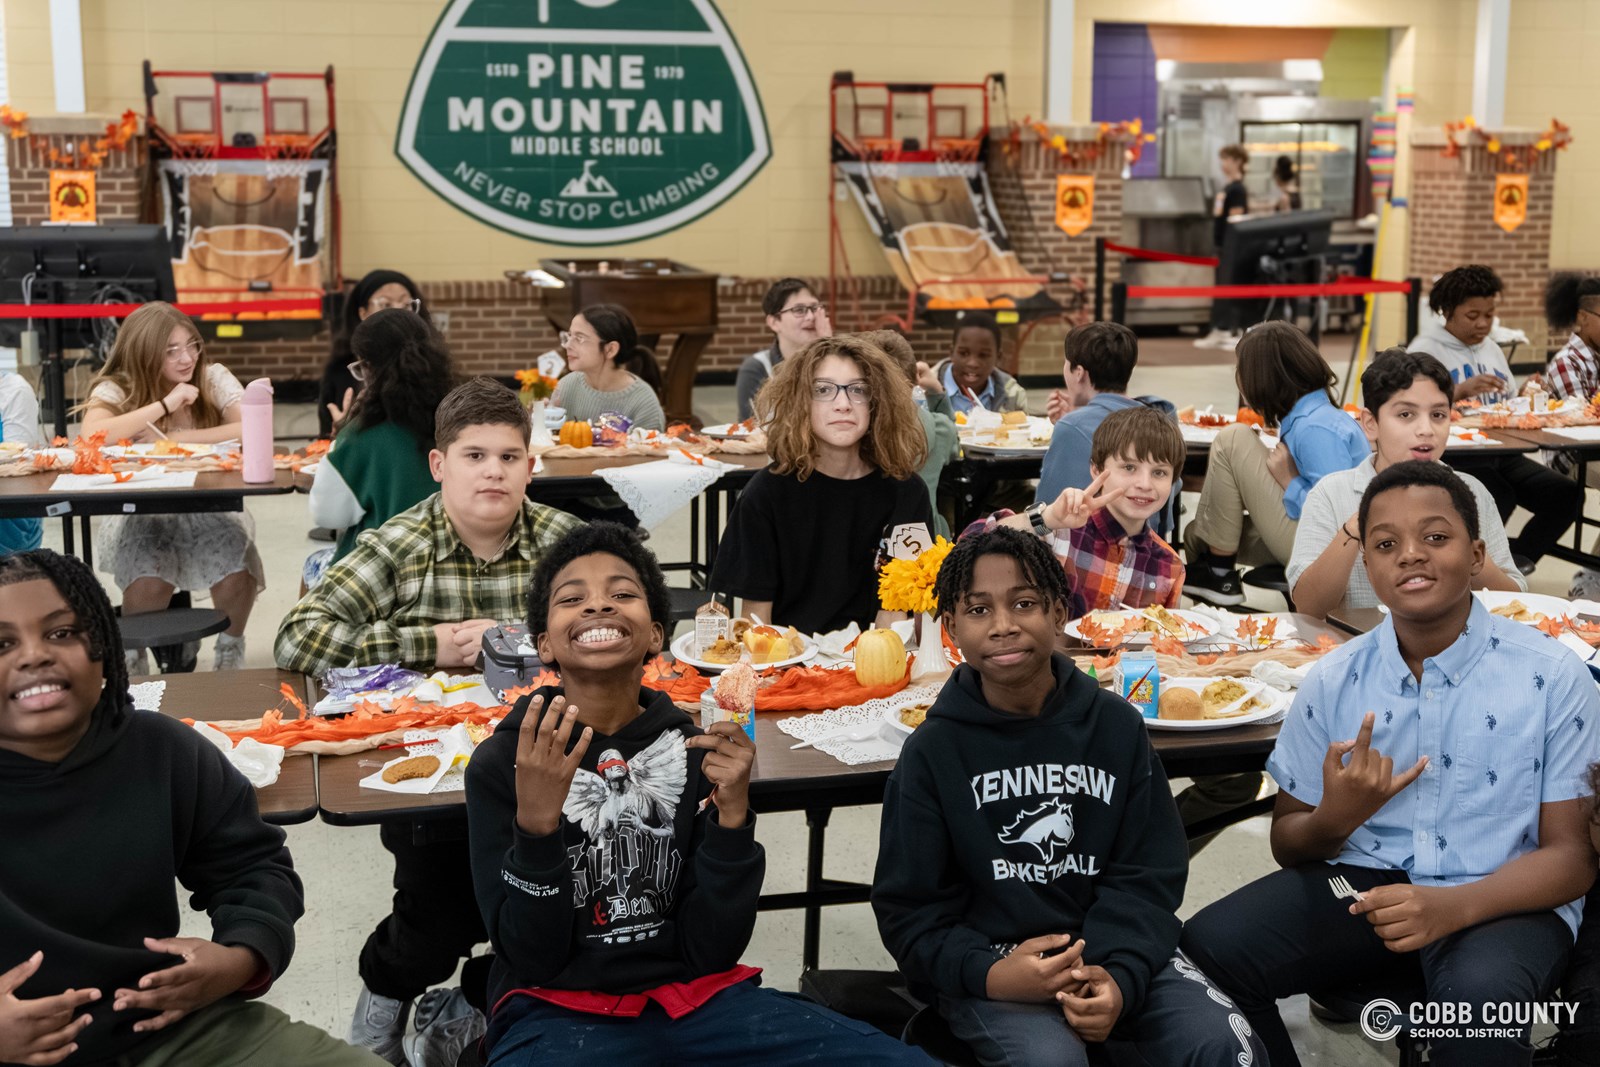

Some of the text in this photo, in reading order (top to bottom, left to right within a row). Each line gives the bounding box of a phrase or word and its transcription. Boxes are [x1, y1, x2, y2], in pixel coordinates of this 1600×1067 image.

[486, 63, 519, 77] ESTD
[528, 53, 646, 90] PINE
[447, 97, 723, 134] MOUNTAIN
[510, 136, 664, 156] MIDDLE SCHOOL
[453, 161, 720, 221] NEVER STOP CLIMBING
[902, 535, 922, 555] 5
[541, 887, 560, 897] SPLY
